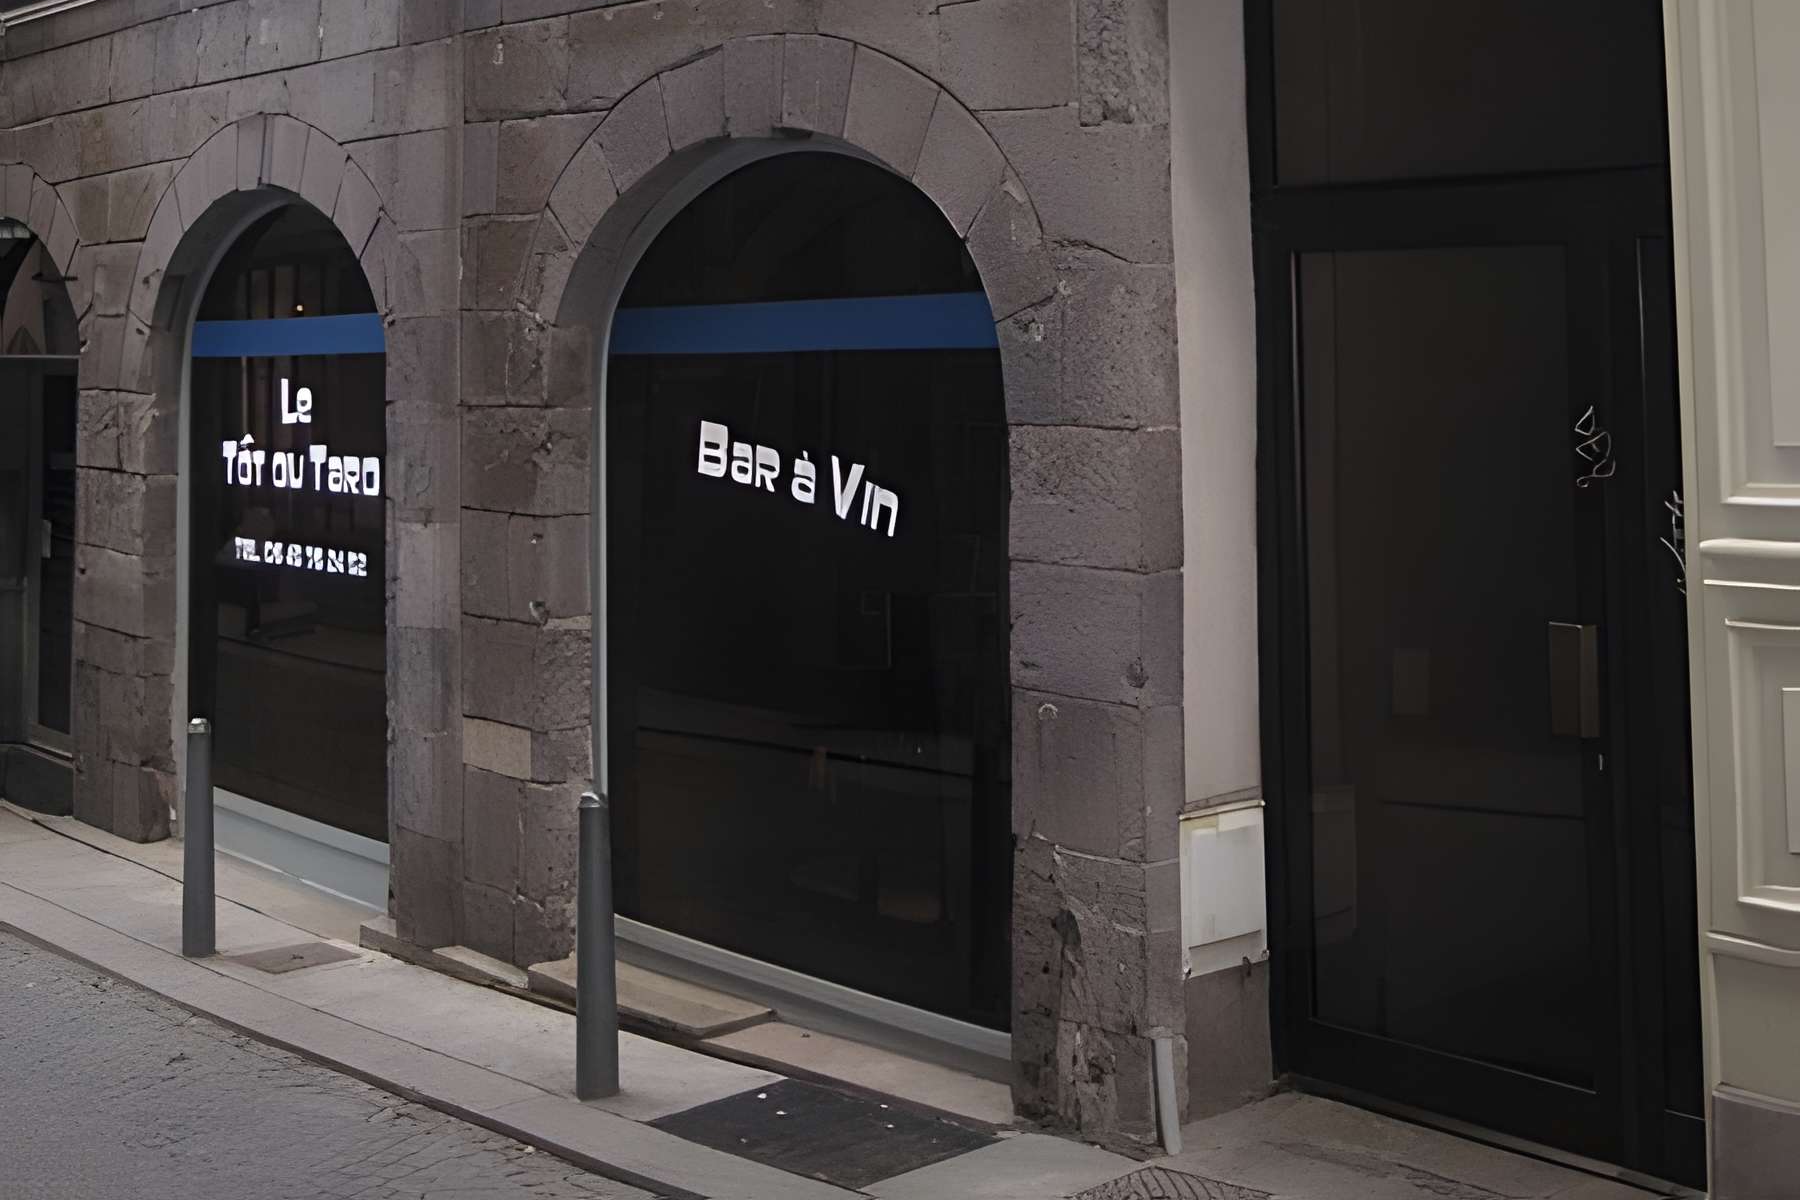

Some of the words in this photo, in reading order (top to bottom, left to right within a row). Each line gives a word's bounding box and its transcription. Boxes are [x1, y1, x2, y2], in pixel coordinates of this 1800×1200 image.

[280, 377, 313, 425] Le
[791, 450, 816, 504] à
[831, 455, 899, 537] Vin
